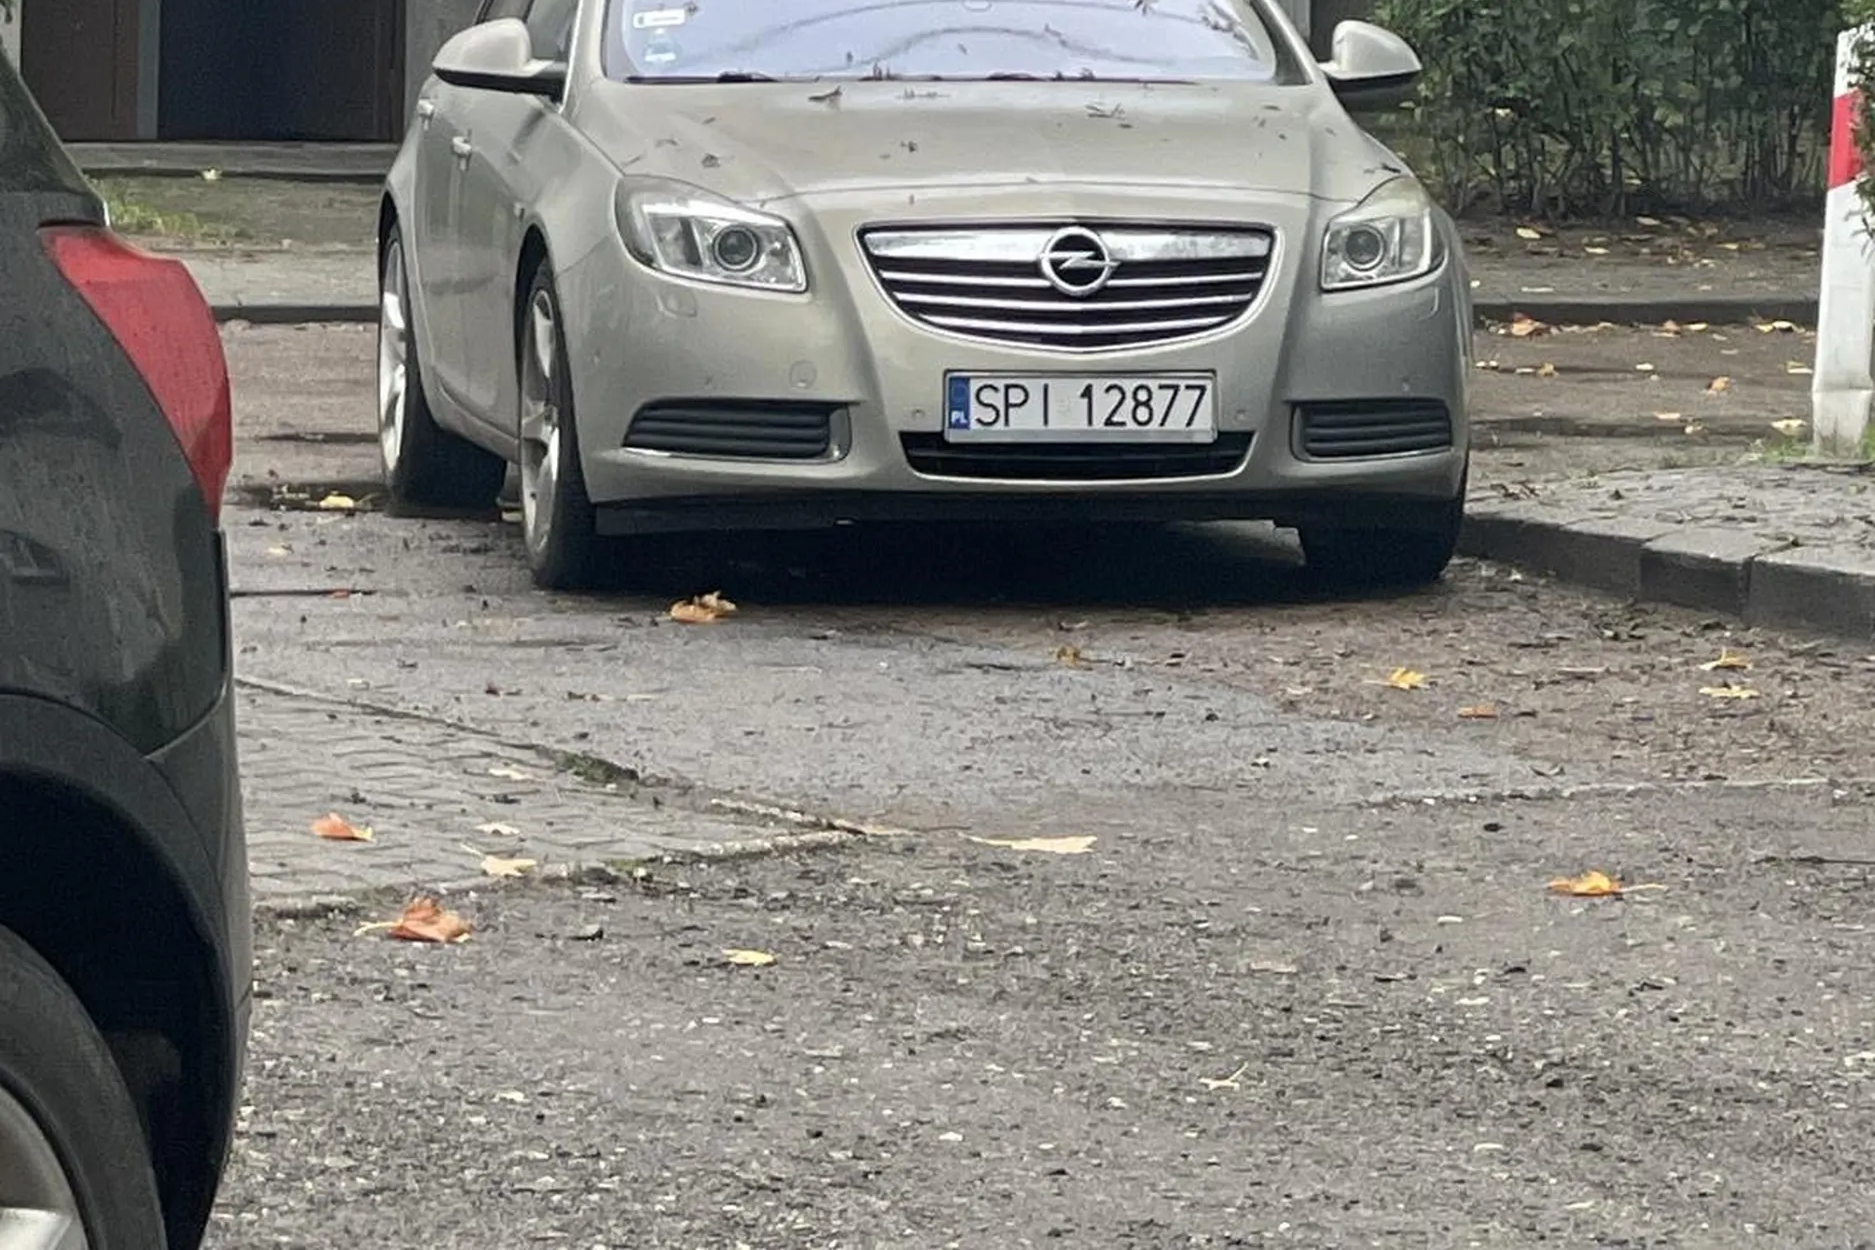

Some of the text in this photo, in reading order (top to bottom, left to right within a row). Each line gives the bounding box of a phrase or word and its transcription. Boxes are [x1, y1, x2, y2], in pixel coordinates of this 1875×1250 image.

[951, 410, 968, 424] PL
[975, 383, 1207, 427] SPI 12877
